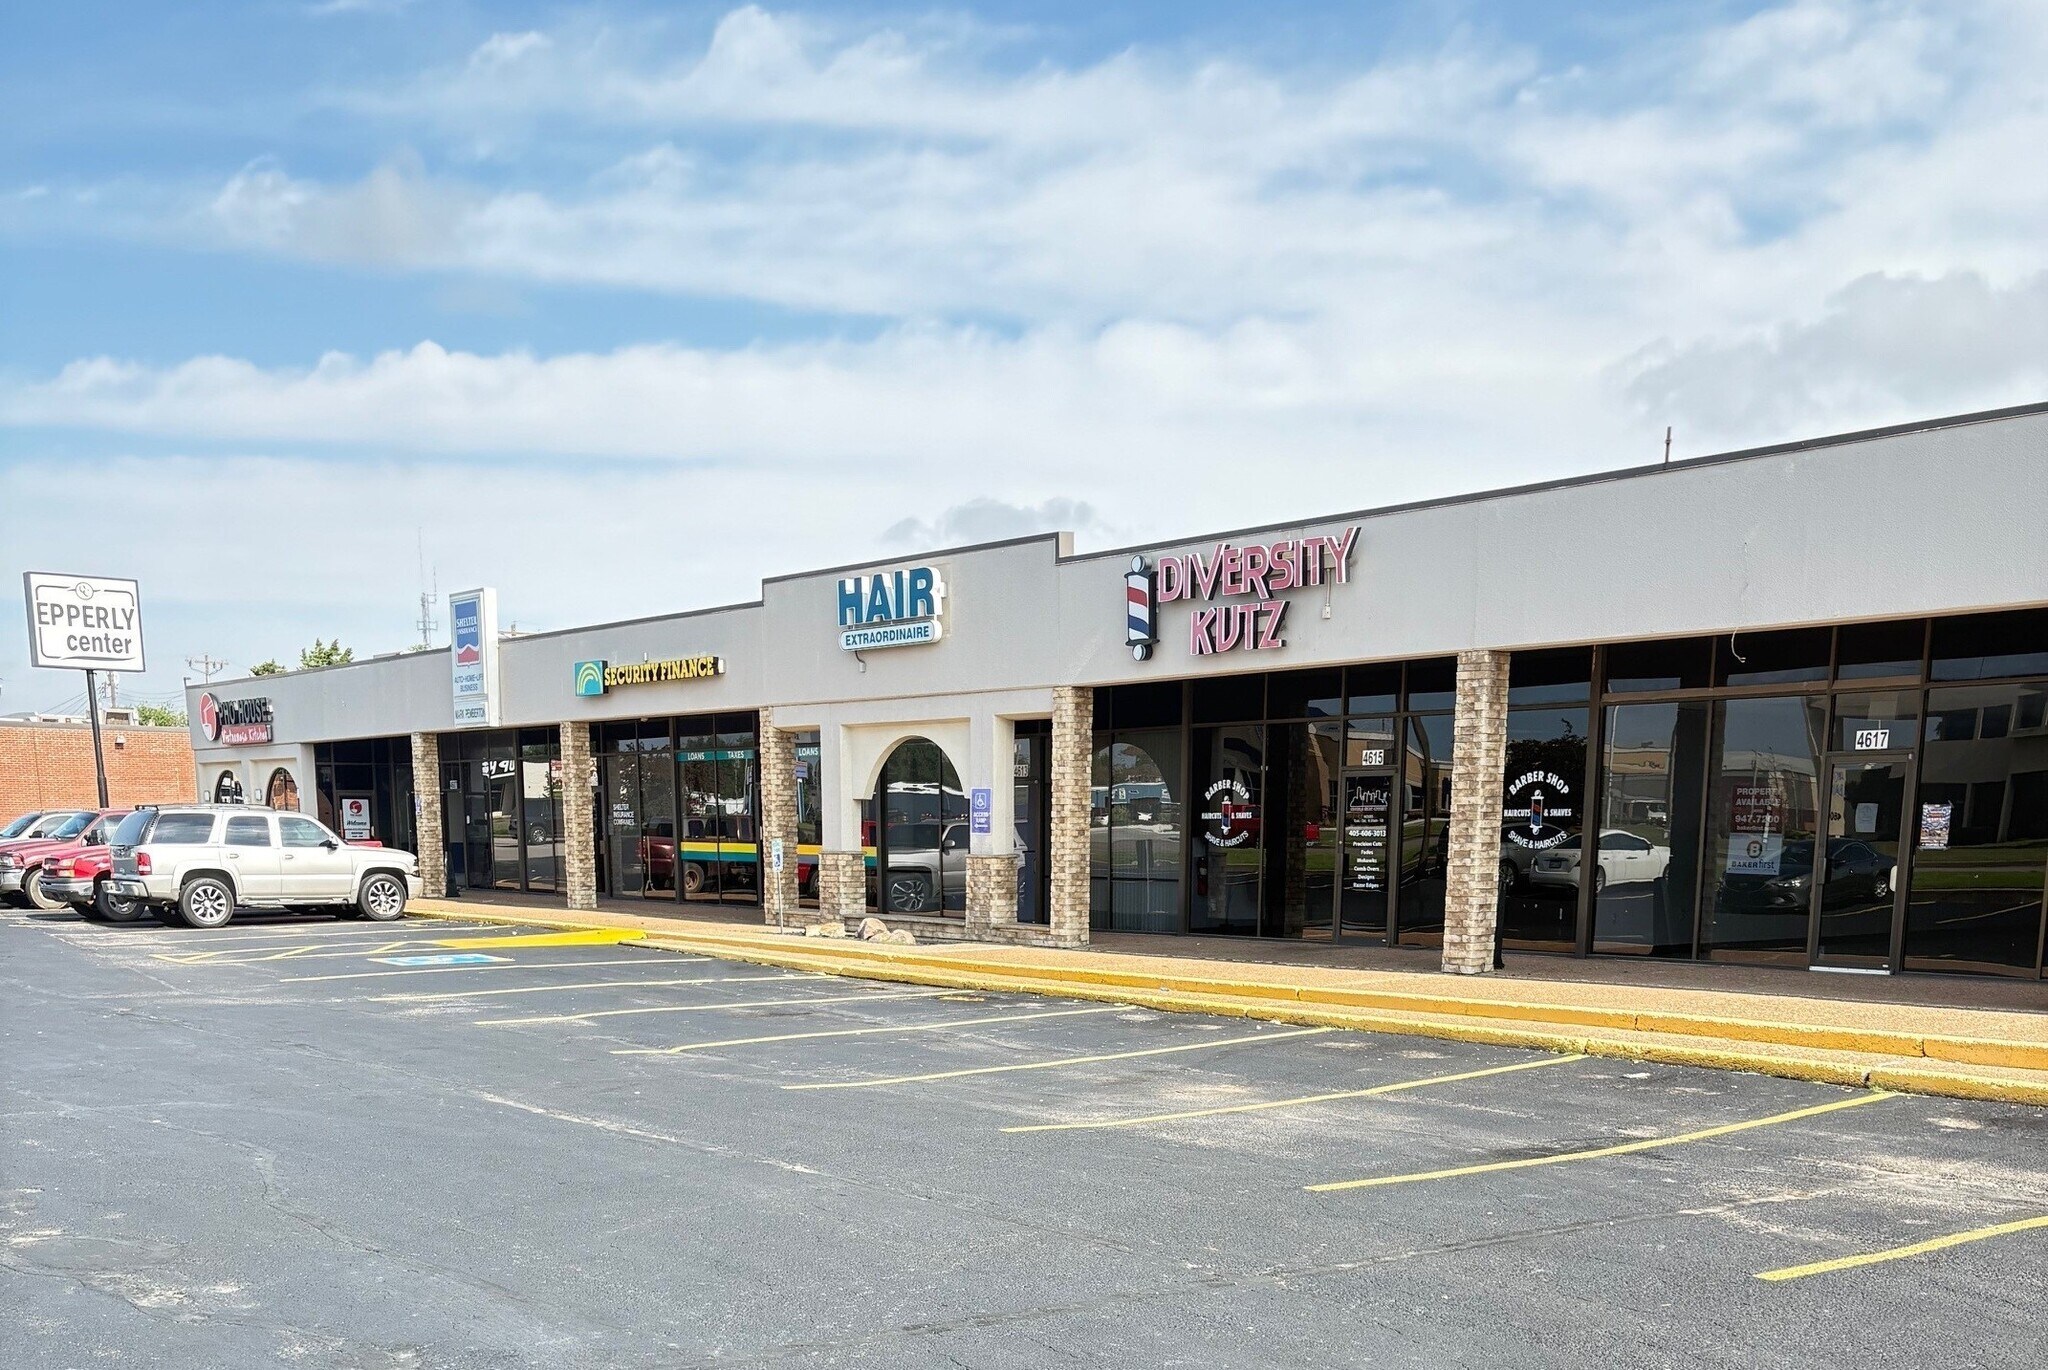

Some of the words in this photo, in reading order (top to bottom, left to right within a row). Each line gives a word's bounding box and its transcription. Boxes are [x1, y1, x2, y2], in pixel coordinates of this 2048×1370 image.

[1158, 527, 1361, 602] DIVERSITY
[838, 567, 936, 626] HAIR
[37, 602, 134, 630] EPPERLY
[456, 615, 478, 628] SHELTER
[845, 625, 930, 646] EXTRAORDINAIRE
[1190, 600, 1290, 655] KUTZ
[66, 633, 131, 654] center
[604, 663, 659, 686] SECURITY
[661, 656, 715, 681] FINANCE
[218, 701, 236, 726] PHO
[238, 696, 270, 724] HOUSE
[1857, 731, 1888, 748] 4617
[687, 752, 705, 760] LOANS
[727, 750, 745, 759] TAXES
[799, 747, 819, 756] LOANS
[1363, 751, 1384, 765] 4615
[1204, 779, 1231, 801] BARBER
[1232, 780, 1250, 800] SHOP
[1509, 770, 1545, 795] BARBER
[1546, 772, 1570, 795] SHOP
[613, 803, 629, 811] SHELTER
[1735, 798, 1781, 806] AVAILABLE
[1503, 808, 1531, 817] HAIRCUTS
[1543, 808, 1549, 816] &
[1550, 808, 1572, 816] SHAVES
[1204, 831, 1220, 846] SHAVE
[1220, 838, 1225, 847] &
[1225, 830, 1249, 847] HAIRCUTS
[1508, 830, 1529, 848] SHAVE
[1528, 840, 1534, 849] &
[1534, 830, 1568, 849] HAIRCUTS
